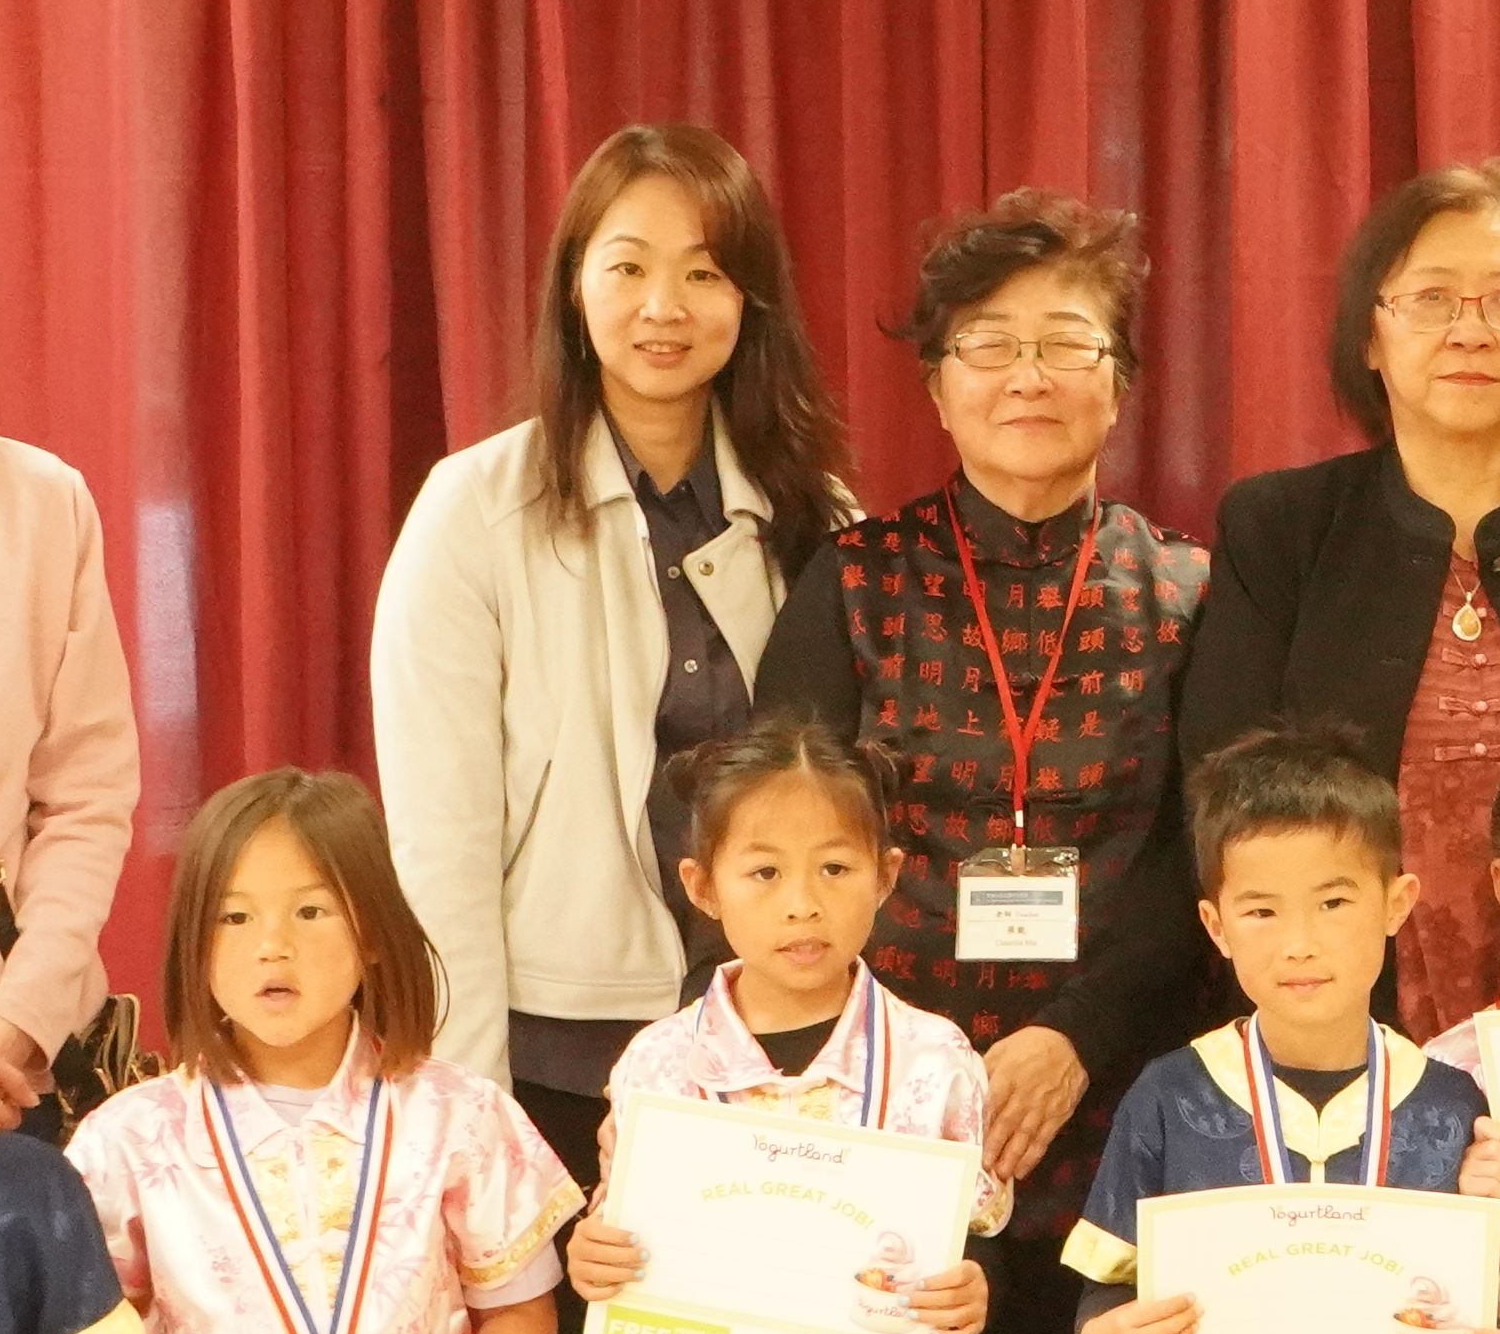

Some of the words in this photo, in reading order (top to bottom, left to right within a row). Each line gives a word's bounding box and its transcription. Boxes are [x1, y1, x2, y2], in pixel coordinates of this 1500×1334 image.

[753, 1134, 845, 1165] Yogurtland
[701, 1180, 755, 1204] REAL
[759, 1180, 830, 1206] GREAT
[830, 1198, 876, 1232] JOB!
[1269, 1204, 1366, 1227] Yogurtland
[1227, 1246, 1281, 1277] REAL
[1285, 1241, 1354, 1258] GREAT
[1359, 1249, 1406, 1276] JOB!
